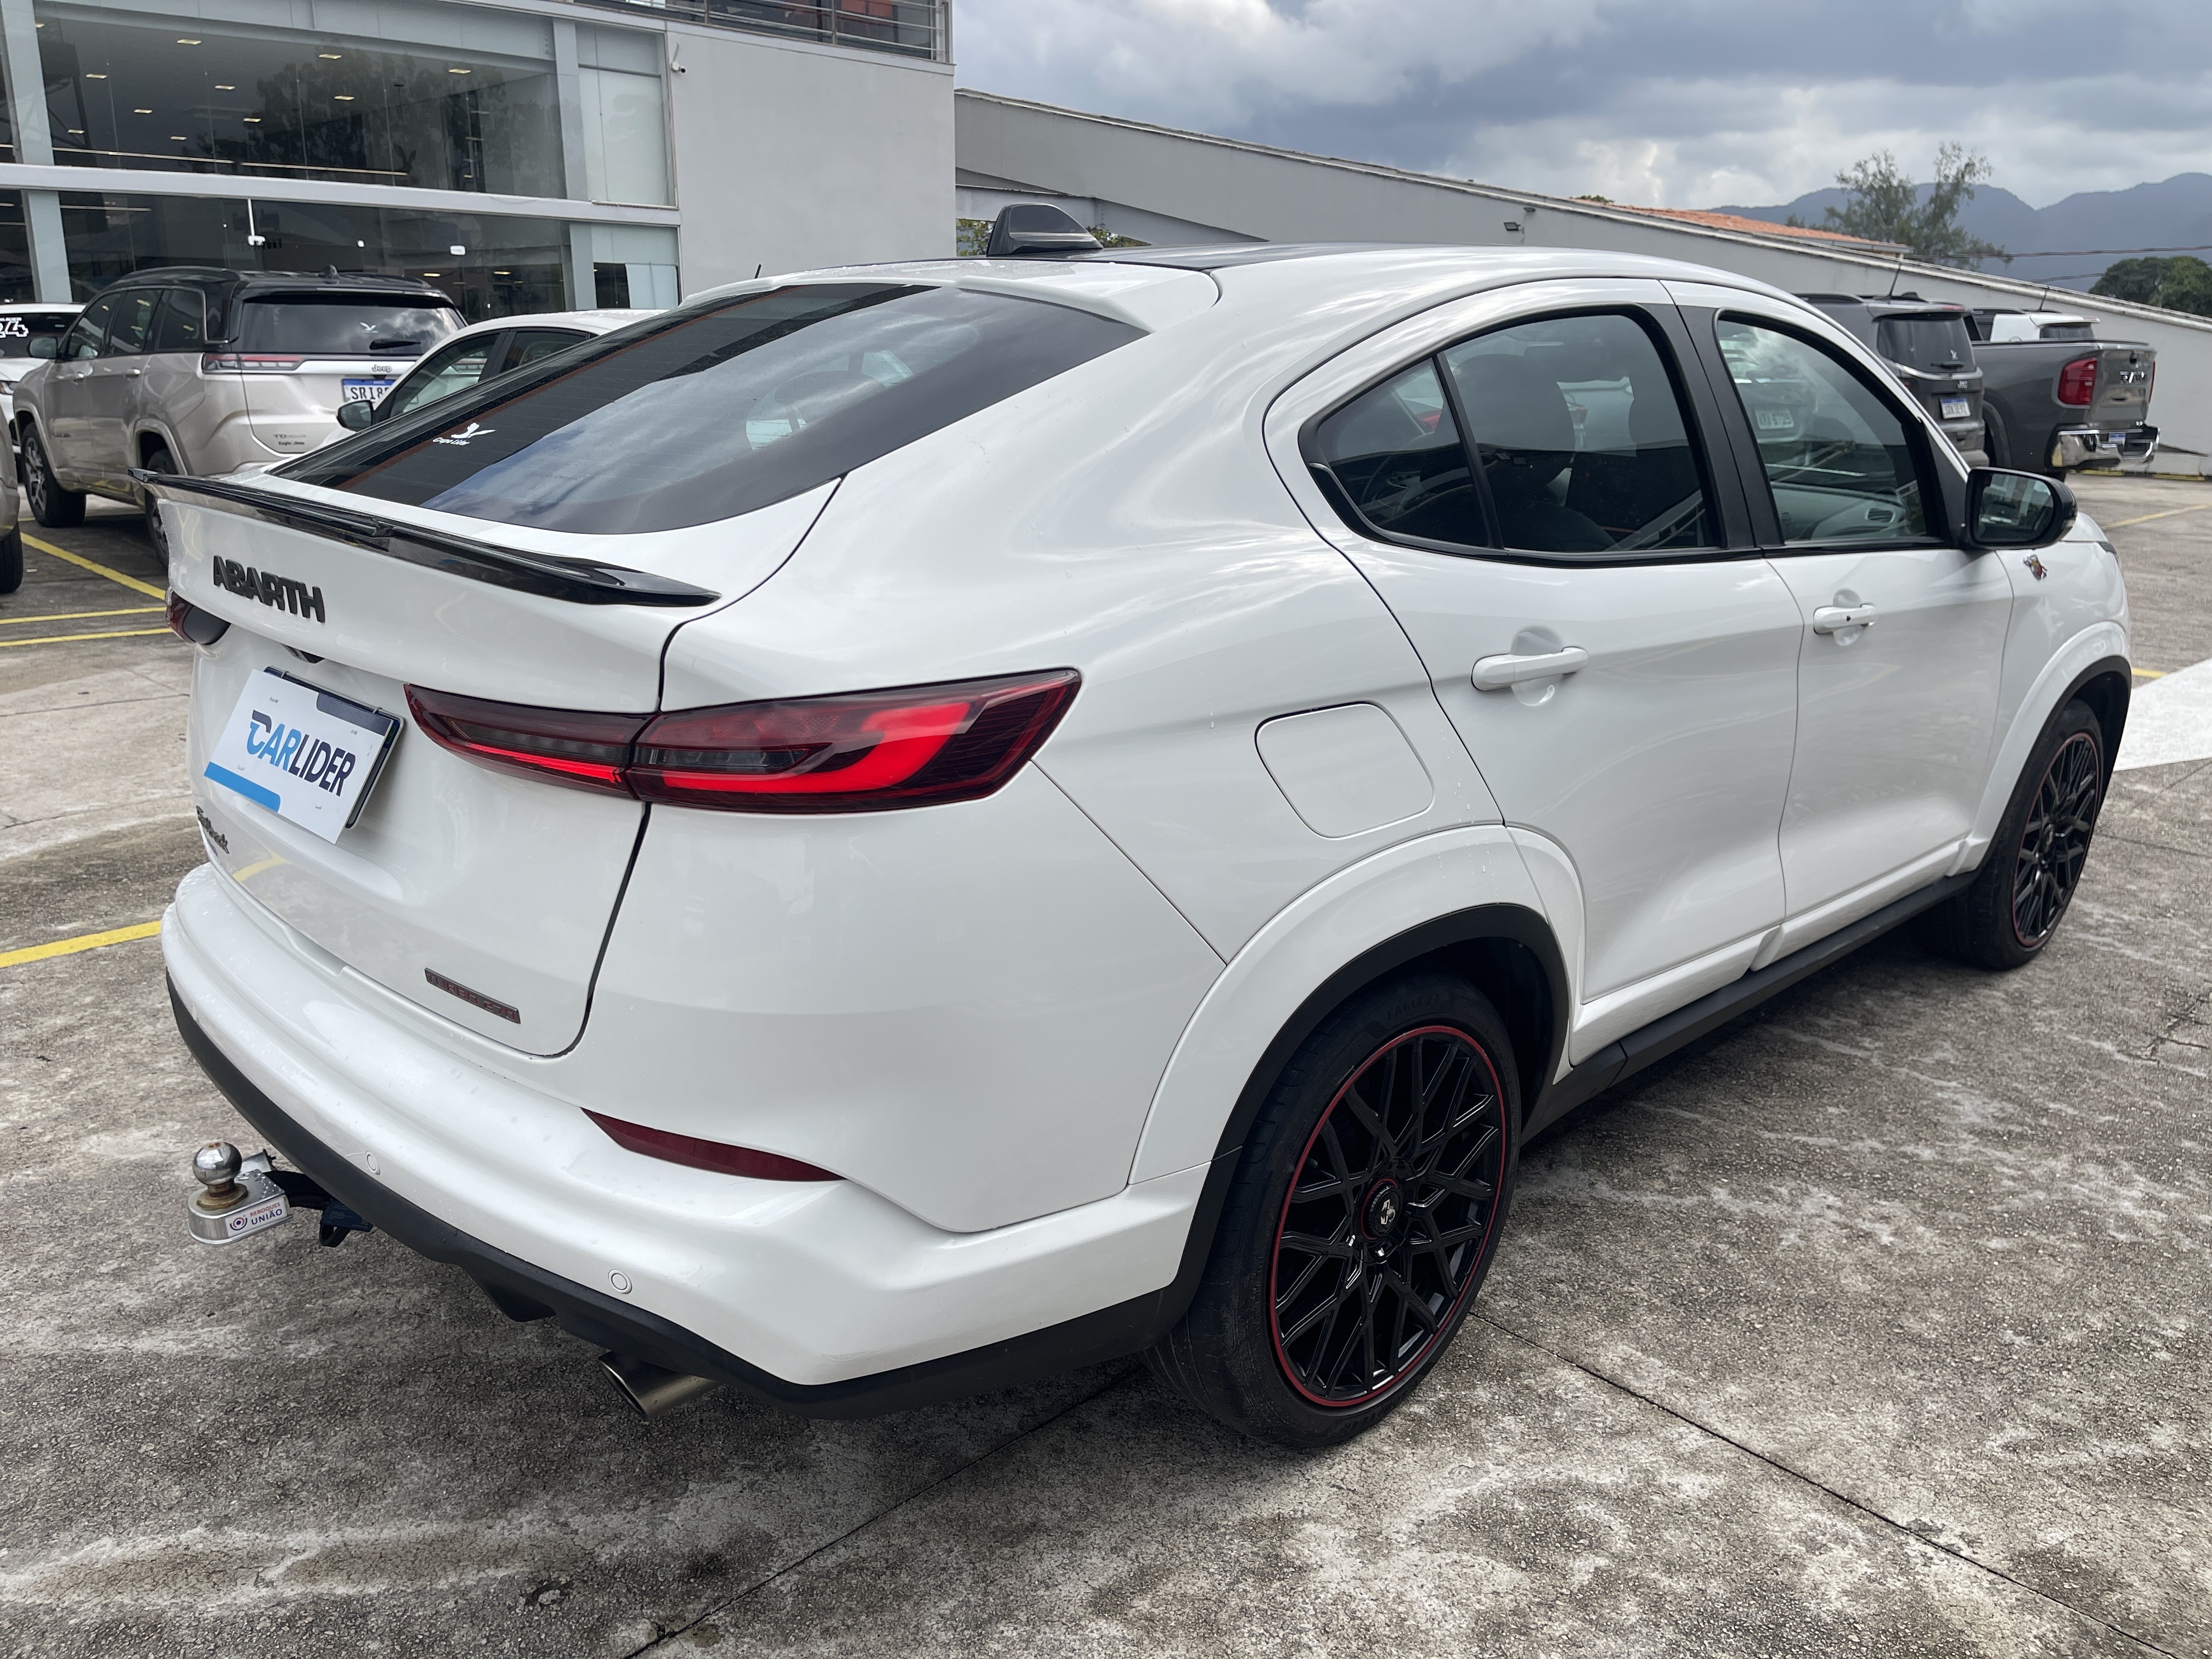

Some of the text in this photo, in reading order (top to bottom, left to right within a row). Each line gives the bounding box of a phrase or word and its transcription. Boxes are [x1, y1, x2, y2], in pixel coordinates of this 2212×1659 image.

[372, 364, 392, 373] Jeep
[213, 555, 325, 623] ABARTH
[247, 709, 356, 797] CARLIDER
[425, 973, 517, 1022] TURBO 270
[250, 1201, 281, 1217] REBOQUES
[251, 1208, 283, 1225] UNIÃO
